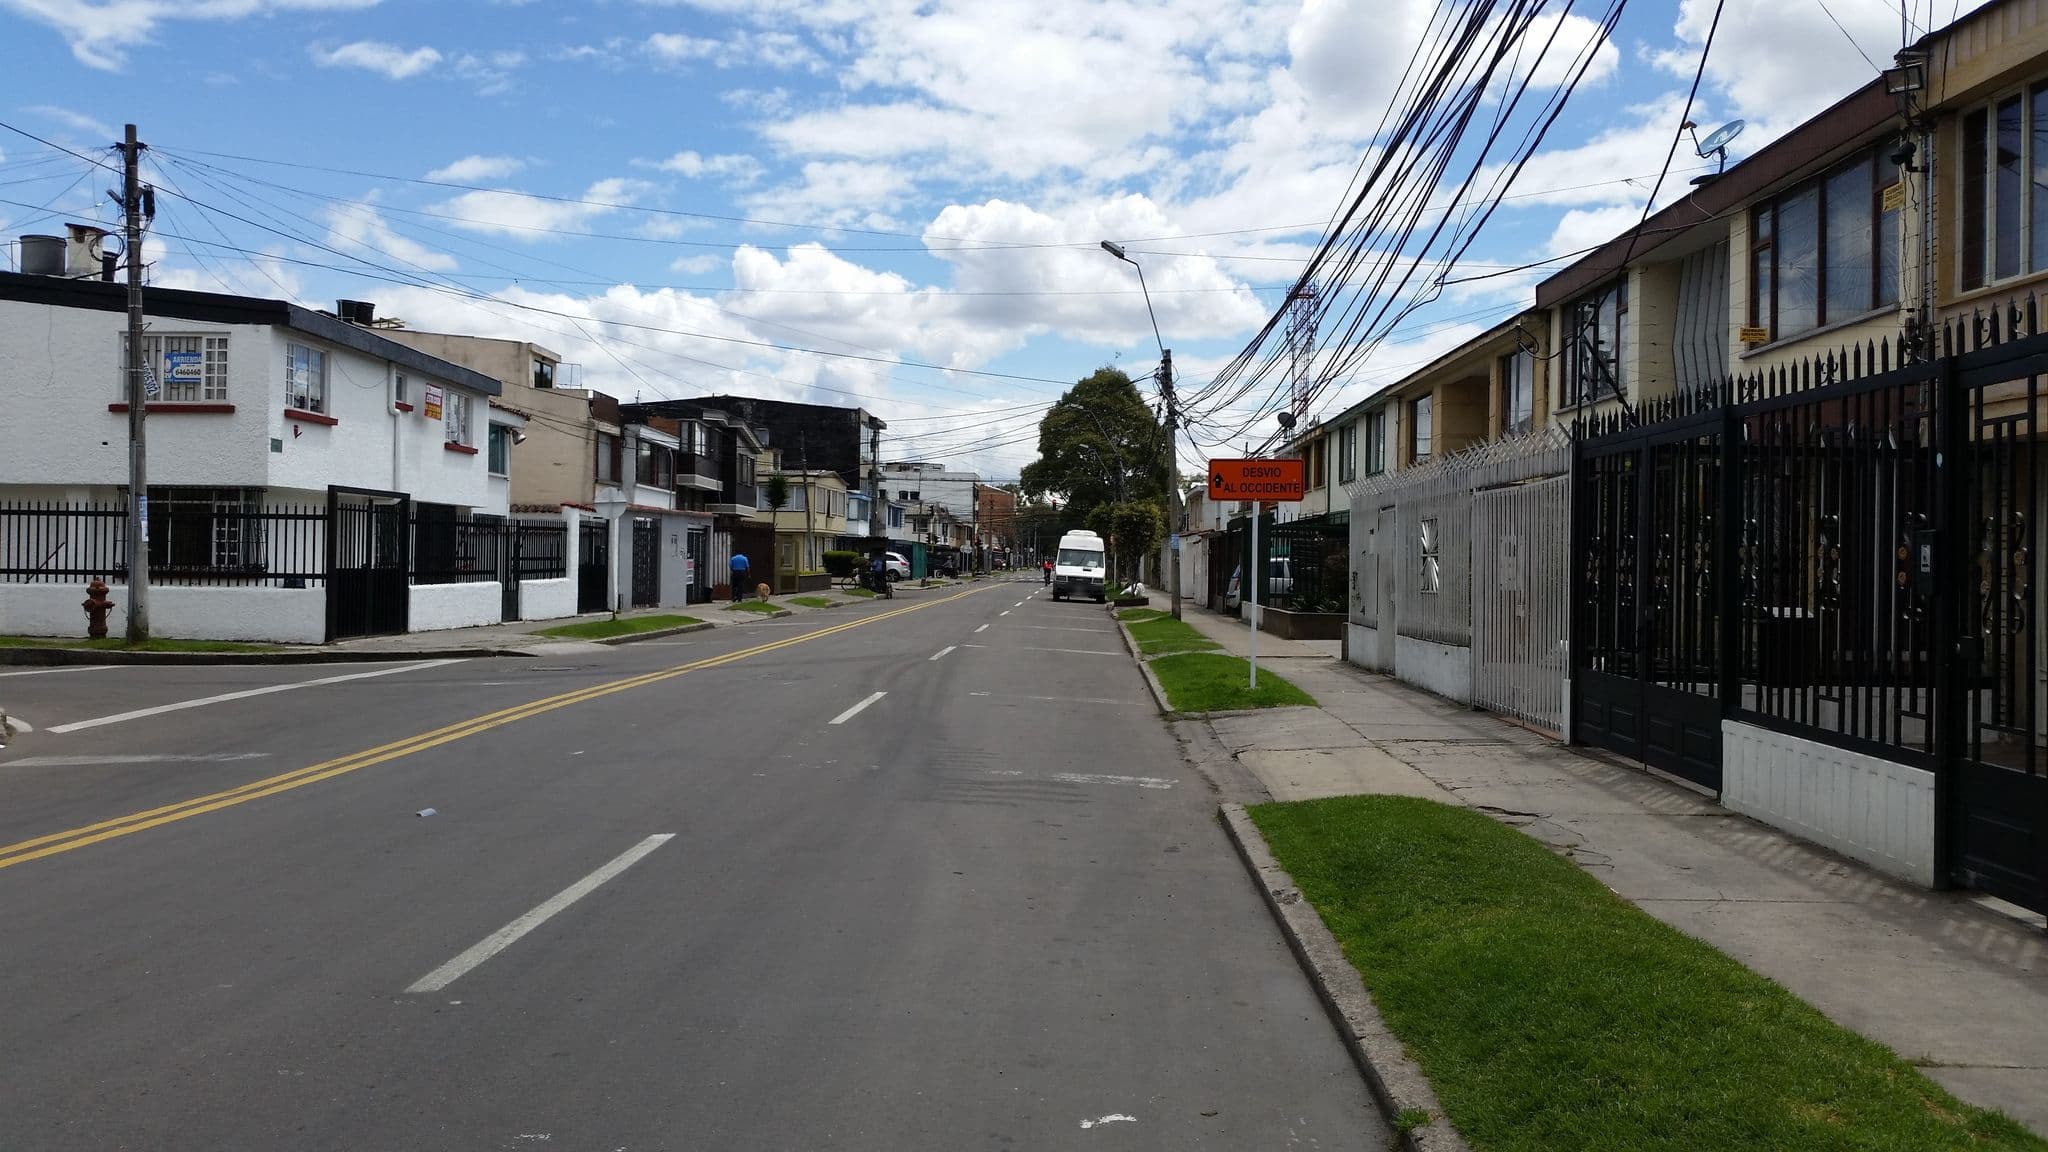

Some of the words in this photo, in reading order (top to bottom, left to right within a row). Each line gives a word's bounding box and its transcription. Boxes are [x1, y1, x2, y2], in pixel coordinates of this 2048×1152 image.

[175, 368, 201, 376] 6460460
[1242, 467, 1281, 478] DESVIO
[1223, 482, 1237, 493] AL
[1239, 482, 1301, 493] OCCIDENTE
